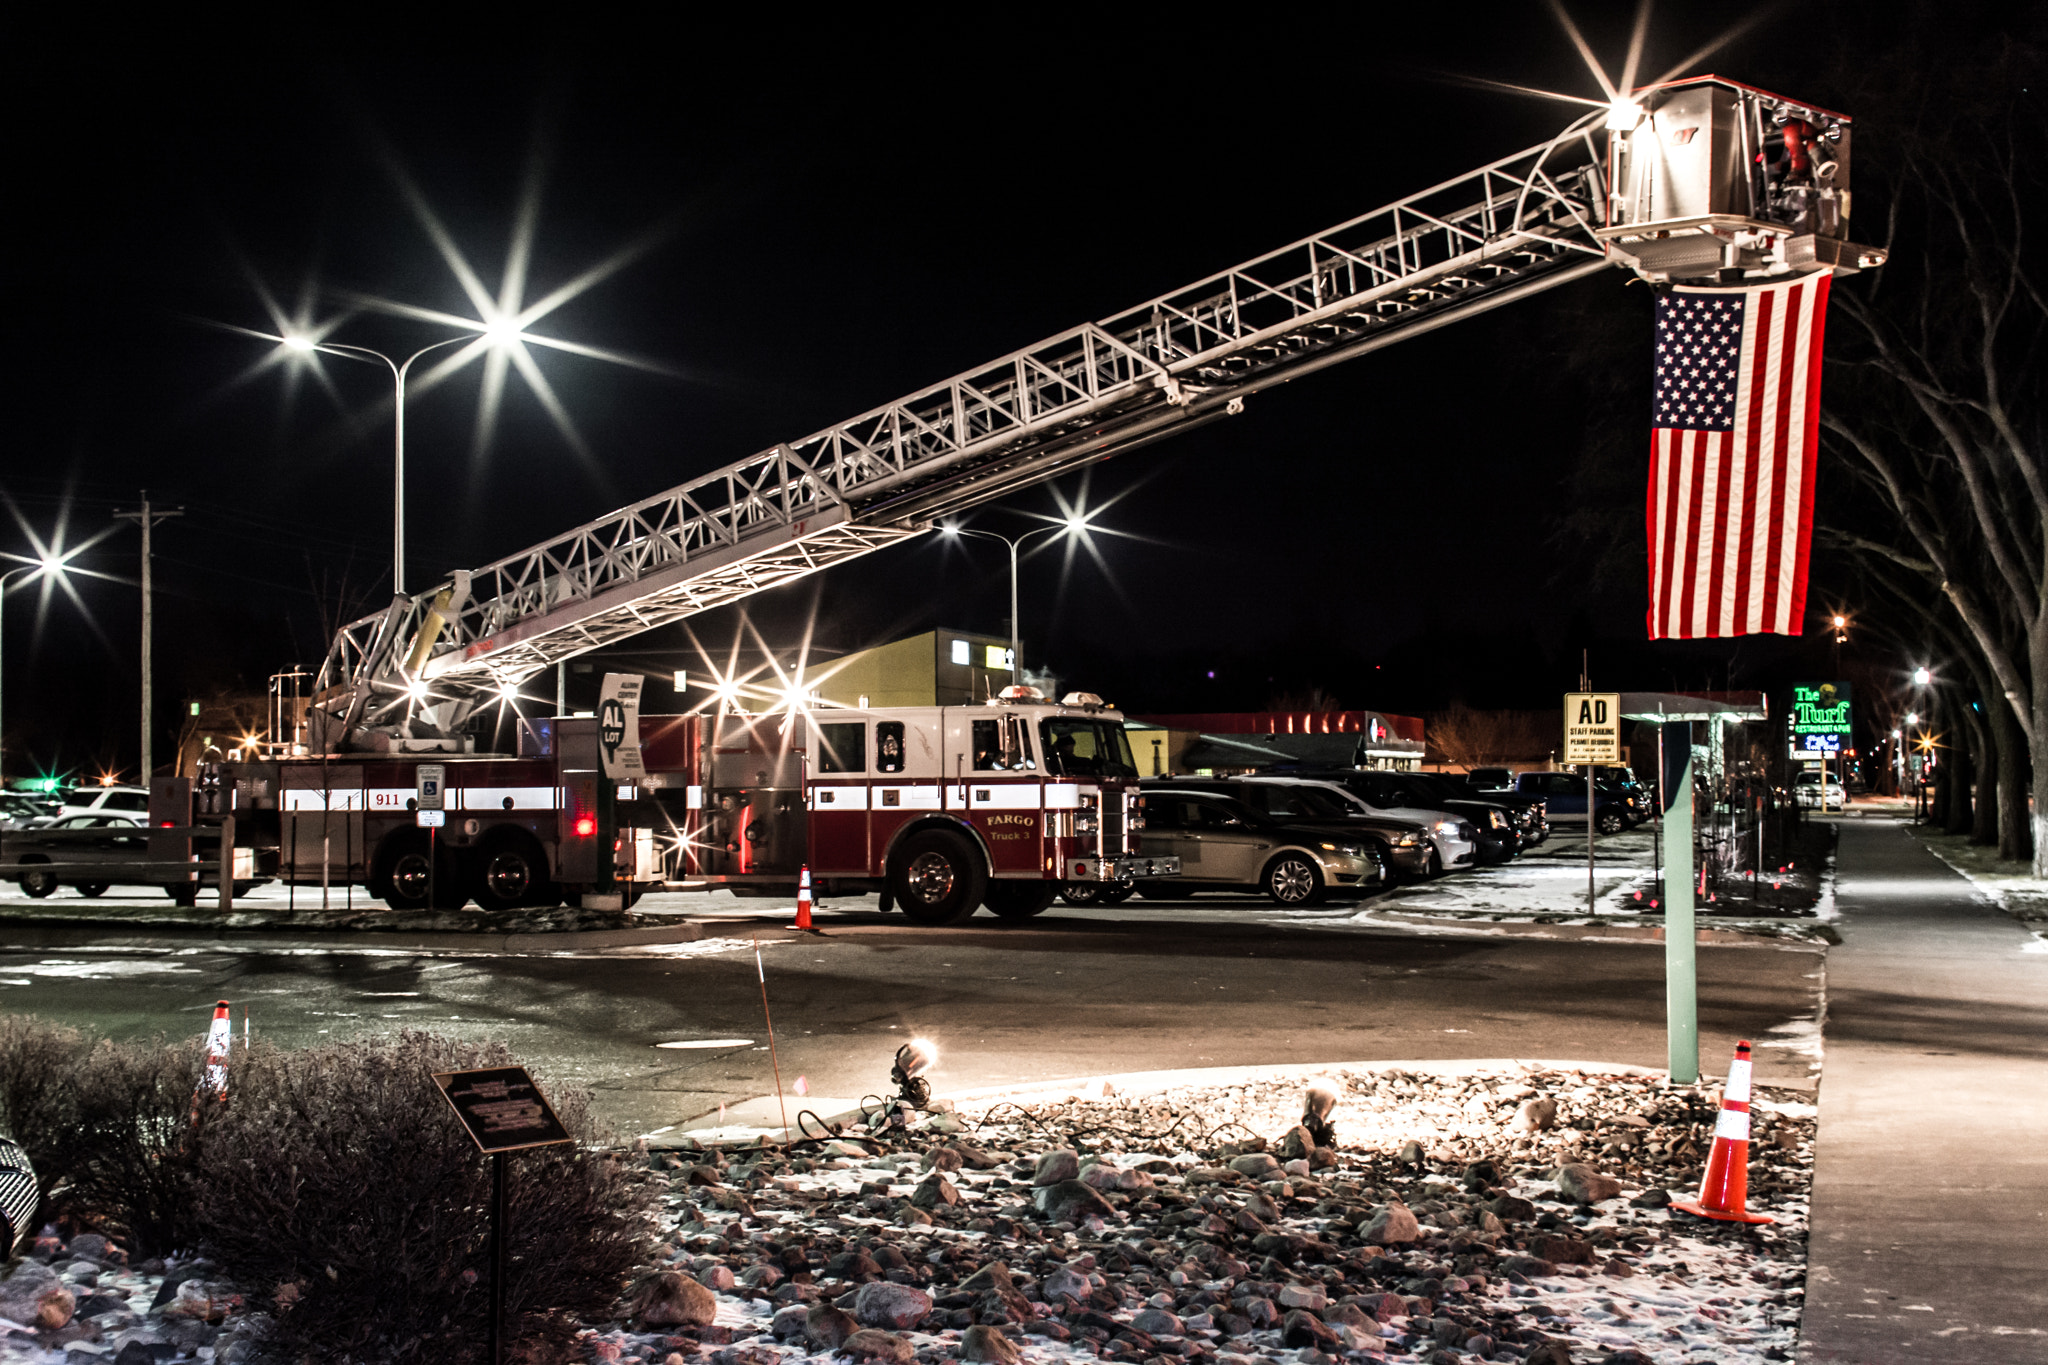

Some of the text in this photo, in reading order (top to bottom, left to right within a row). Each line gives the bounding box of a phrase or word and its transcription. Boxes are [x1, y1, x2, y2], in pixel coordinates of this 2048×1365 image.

[1794, 686, 1820, 702] The
[602, 705, 624, 728] AL
[1578, 699, 1607, 725] AD
[1794, 700, 1850, 724] Turf
[1569, 727, 1615, 736] STAFF PARKING
[1794, 724, 1833, 734] RESTAURANT
[604, 731, 620, 743] LOT
[1570, 738, 1615, 746] PERMIT REQUIRED
[376, 793, 399, 806] 911
[986, 814, 1034, 827] FARGO
[990, 831, 1030, 840] Truck 3
